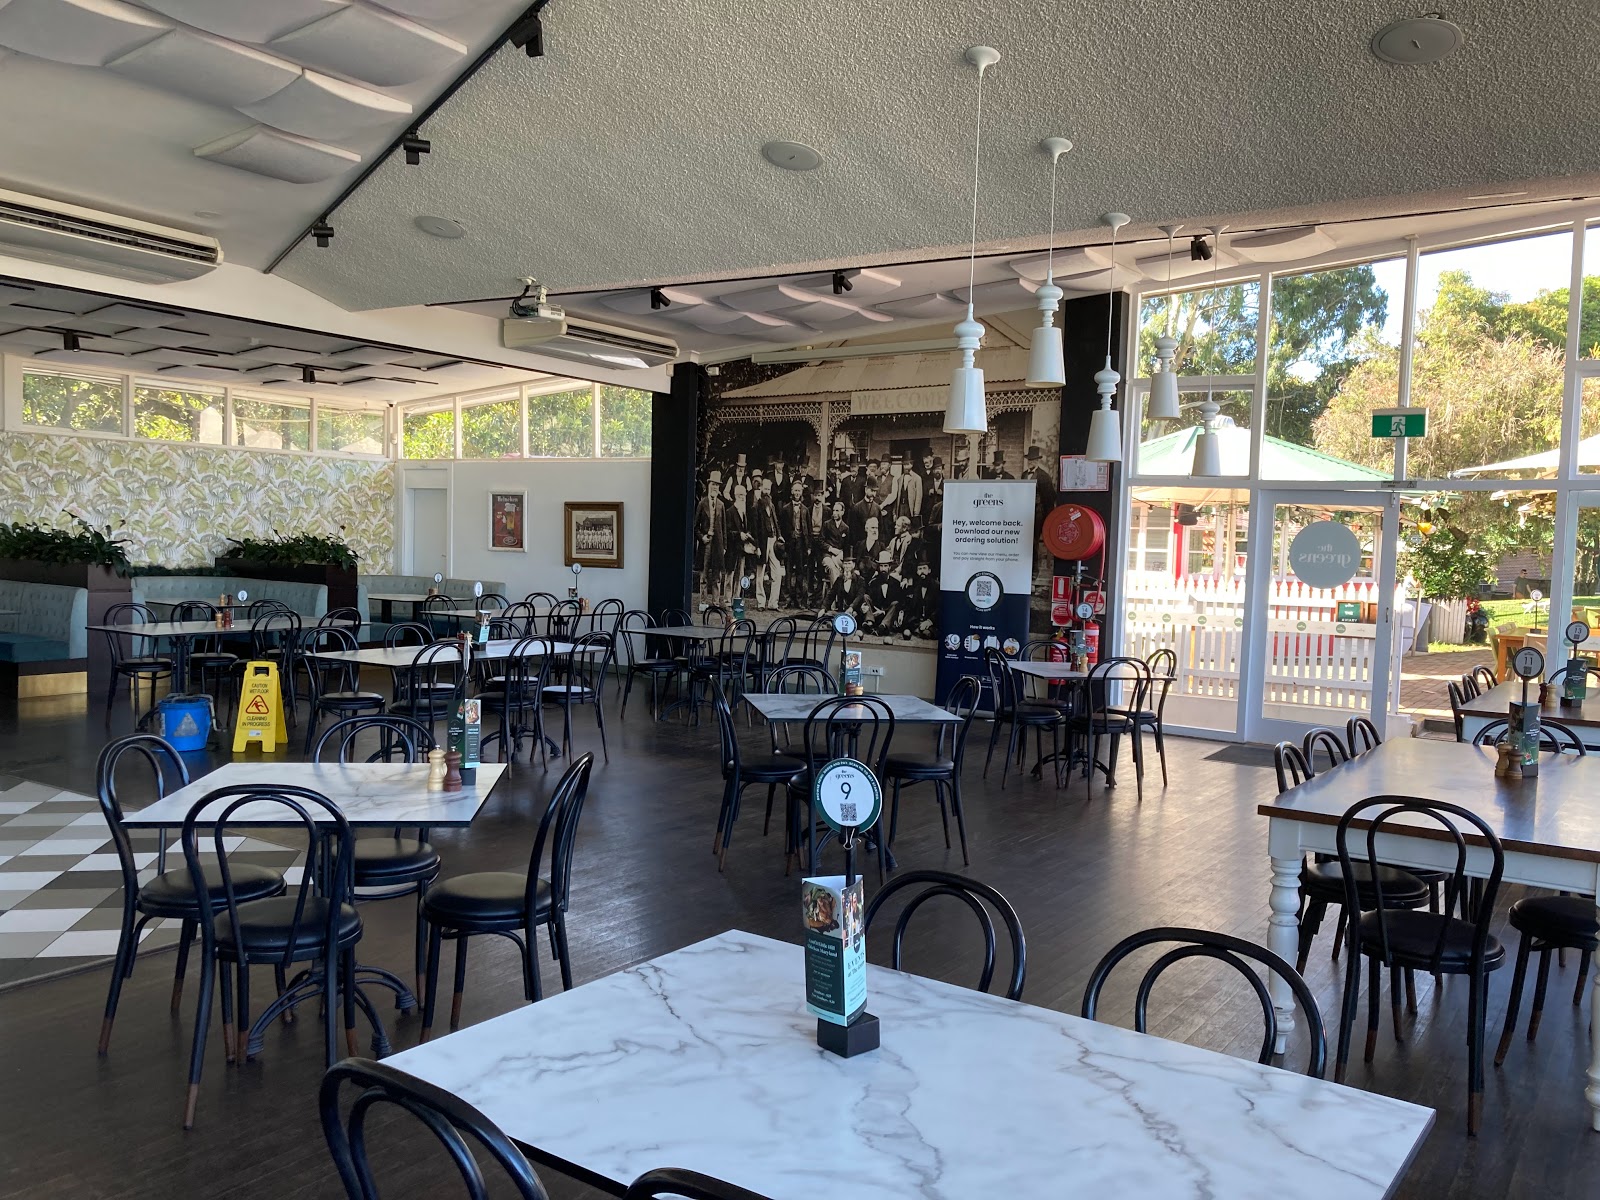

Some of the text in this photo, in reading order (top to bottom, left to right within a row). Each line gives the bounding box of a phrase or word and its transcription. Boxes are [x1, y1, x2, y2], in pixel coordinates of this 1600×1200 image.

[973, 499, 1004, 508] greens
[955, 537, 985, 545] ordering
[1524, 656, 1533, 666] 11
[841, 782, 852, 800] 9
